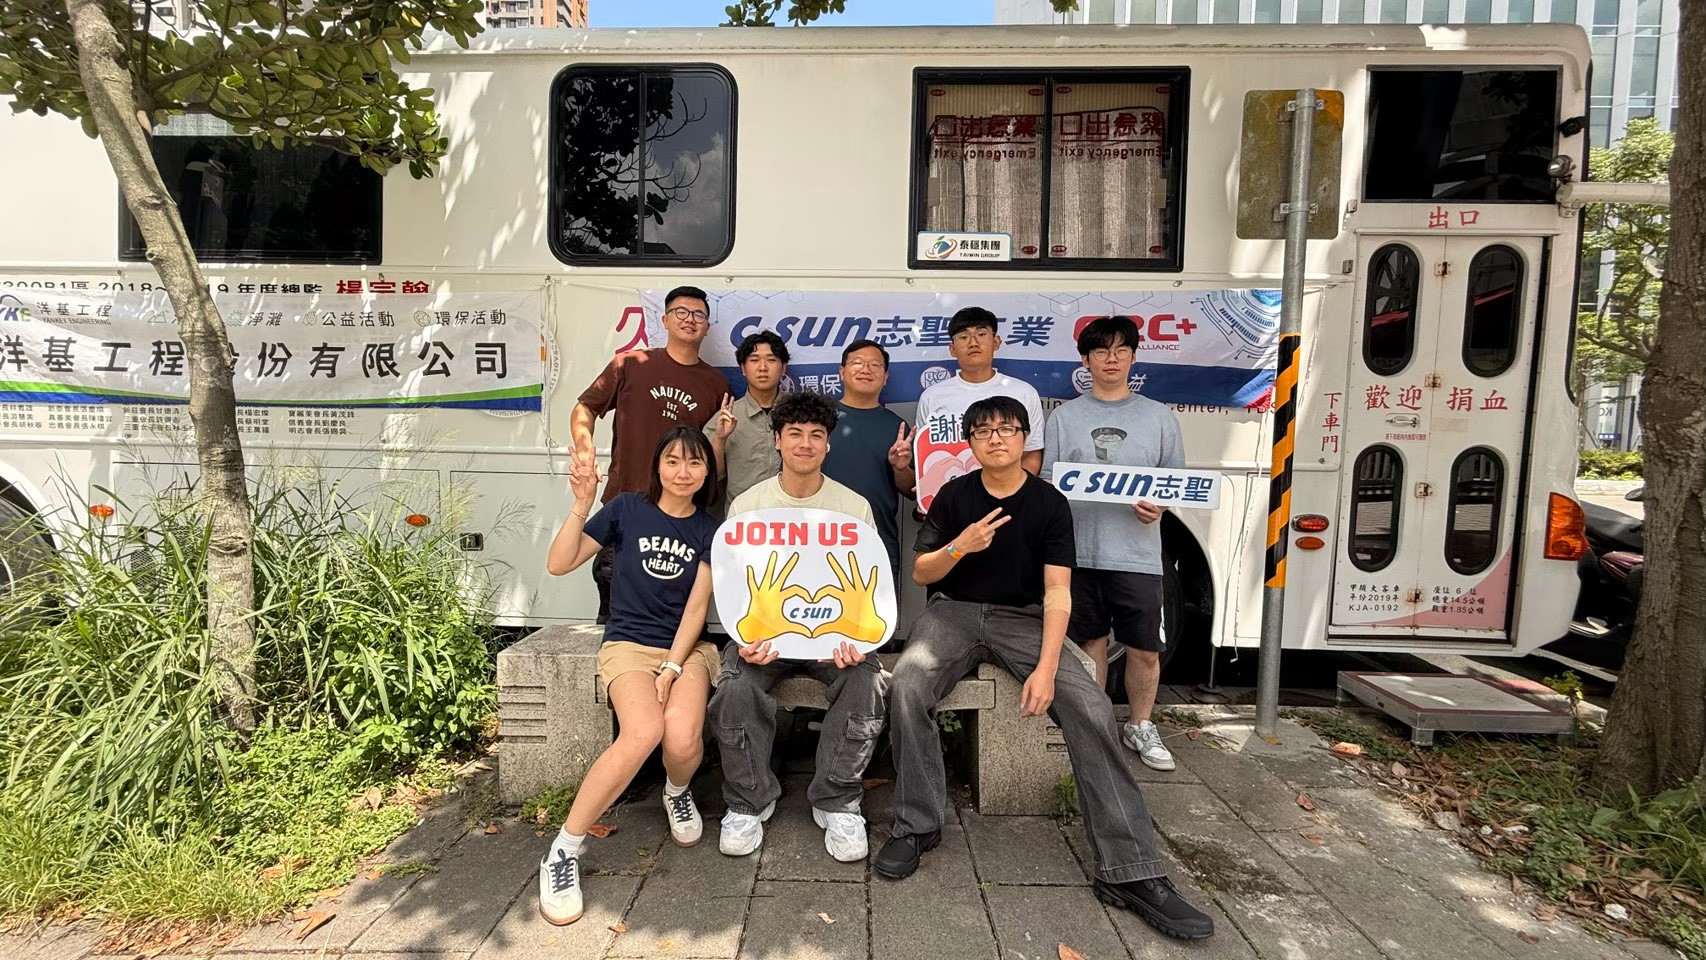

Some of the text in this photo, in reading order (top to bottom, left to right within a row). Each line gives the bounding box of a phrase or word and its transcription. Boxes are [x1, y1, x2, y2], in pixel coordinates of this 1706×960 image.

[1428, 206, 1480, 229] 出口
[36, 302, 113, 317] 洋基工程
[321, 310, 396, 328] 公益活動
[435, 308, 507, 327] 環保活動
[870, 314, 1055, 349] 志聖業
[0, 334, 508, 380] 洋基工程份有限公司
[1127, 373, 1148, 392] 益
[650, 385, 698, 412] NAUTICA
[666, 401, 679, 414] EST.
[1363, 384, 1509, 412] 歡迎捐血
[1321, 391, 1342, 454] 下車門
[1058, 470, 1081, 492] c
[724, 522, 859, 546] JOIN US
[638, 536, 696, 562] BEAMS
[648, 557, 681, 574] HEART
[801, 606, 833, 620] sun
[1349, 603, 1399, 612] KJA-0192
